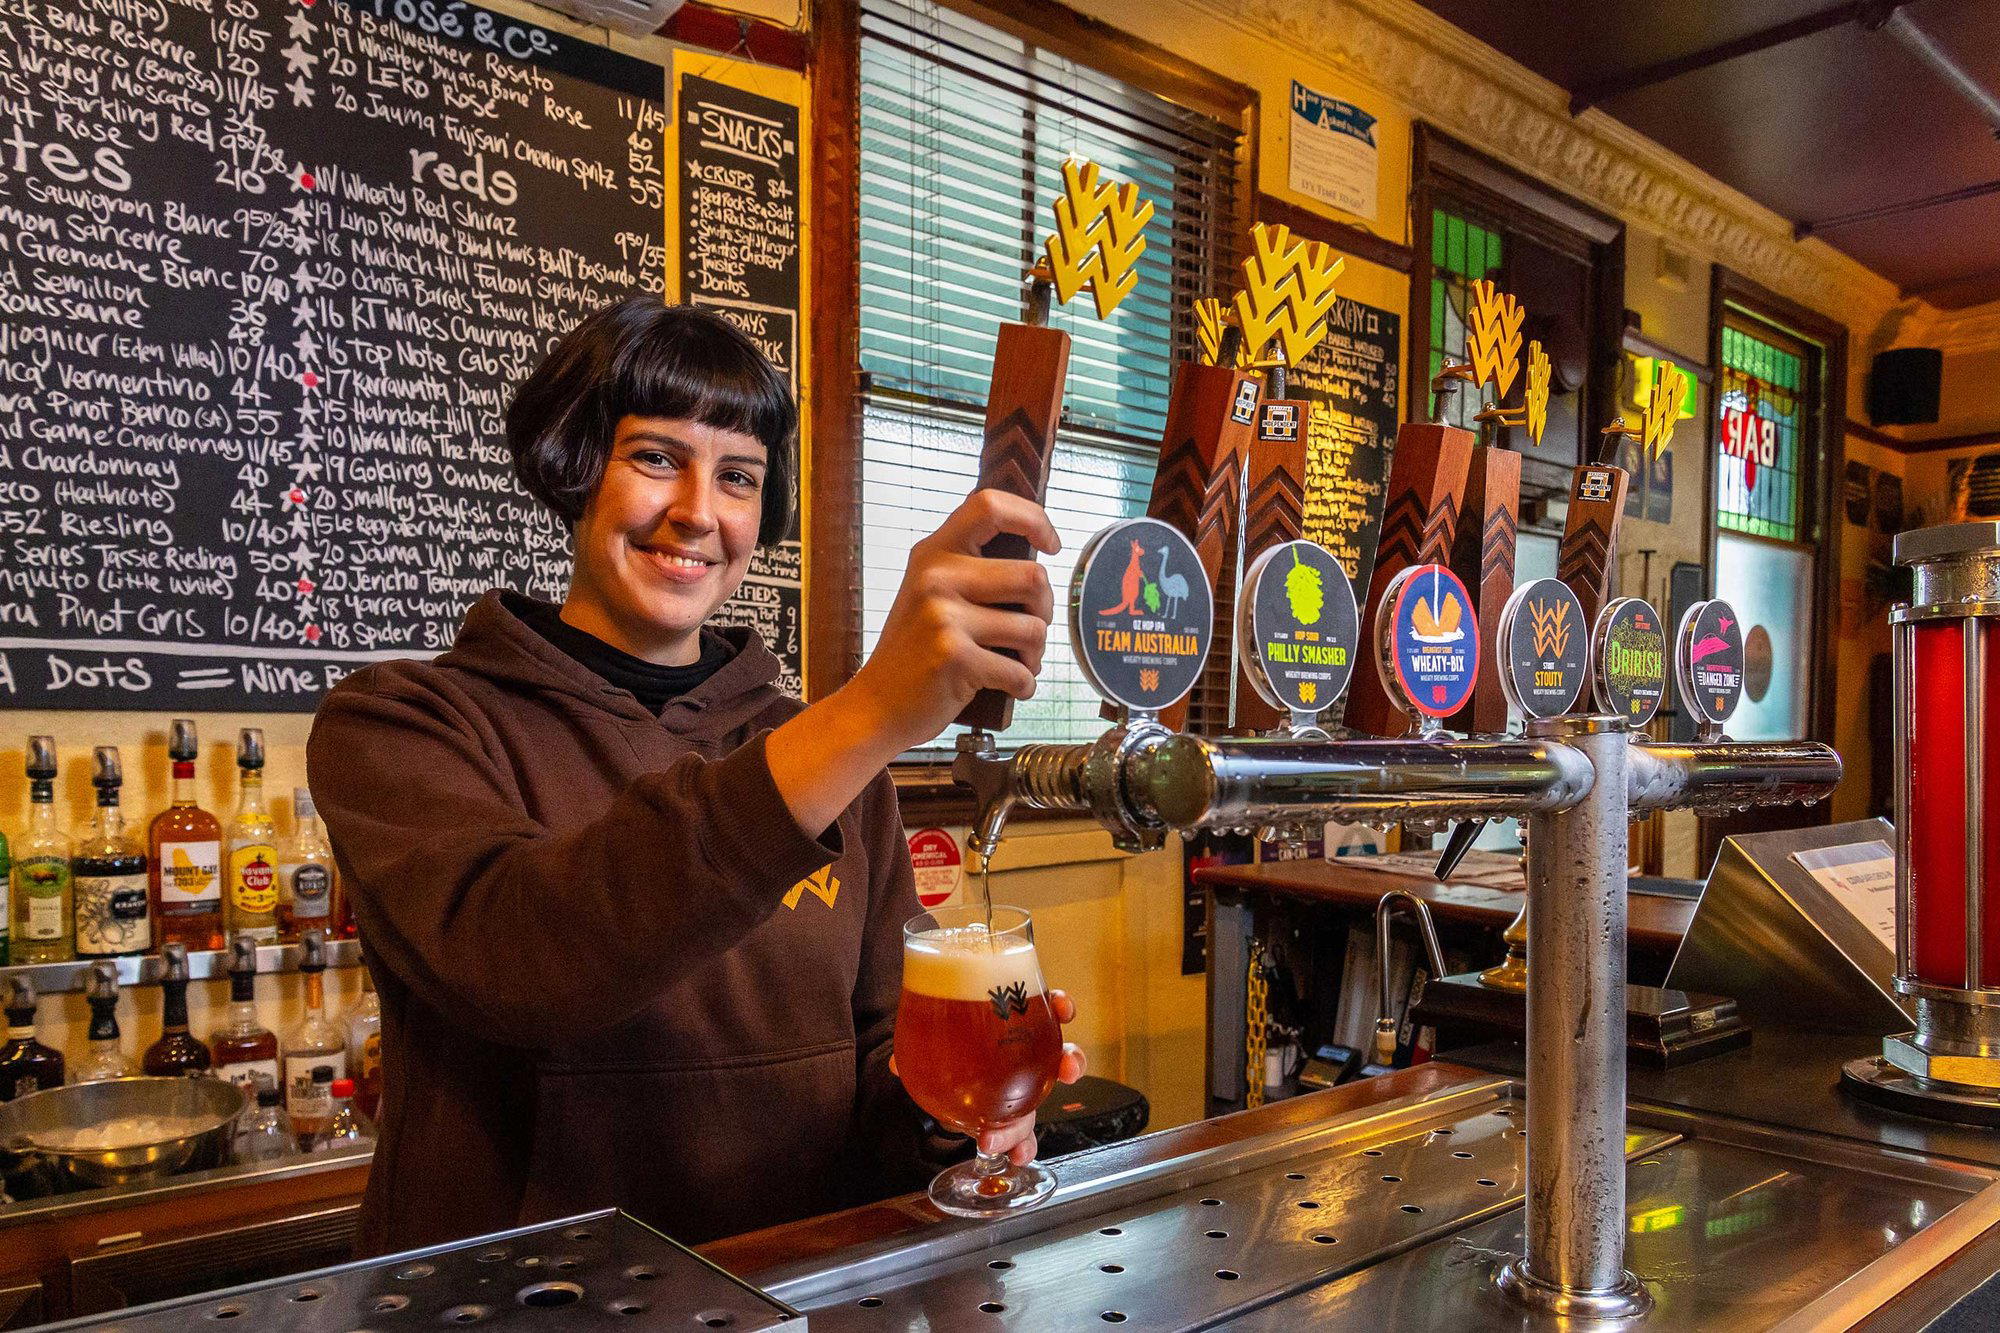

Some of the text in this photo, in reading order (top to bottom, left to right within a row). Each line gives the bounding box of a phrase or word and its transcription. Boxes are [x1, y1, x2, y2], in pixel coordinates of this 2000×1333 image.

[170, 113, 215, 152] Red
[701, 110, 782, 160] SNACKS
[215, 160, 266, 194] 210
[409, 148, 518, 206] reds
[628, 150, 661, 175] 52
[703, 165, 755, 189] CRISPS
[25, 177, 231, 239] Sauvignon Blanc
[412, 187, 450, 225] Red
[452, 201, 518, 237] Shiraz
[66, 214, 279, 272] Sancerre 70
[17, 232, 157, 283] Grenache
[161, 260, 237, 290] Blanc
[32, 268, 268, 327] Semillon 36
[698, 270, 749, 298] Doritos
[352, 296, 388, 332] KT
[228, 323, 264, 347] 48
[229, 344, 297, 382] 10/40
[396, 341, 451, 375] Note
[458, 347, 499, 376] Cab
[57, 362, 271, 407] Vermentino 44
[46, 391, 282, 436] Pinot 55
[117, 428, 296, 467] Chardonnay 11/45
[22, 447, 269, 490] Chardonnay 40
[350, 457, 433, 489] Golding
[230, 489, 273, 516] 44
[60, 511, 289, 548] Riesling 10/40
[249, 551, 291, 574] 50
[349, 566, 419, 594] Jericho
[254, 576, 292, 601] 40
[56, 593, 296, 641] Pinot Gris 10/40
[787, 606, 796, 625] 9
[353, 620, 418, 649] Spider
[1097, 629, 1198, 656] TEAM AUSTRALIA
[1268, 642, 1346, 666] PHILLY SMASHER
[1411, 655, 1464, 672] WHEATY-BIX
[1535, 671, 1563, 687] STOUTY
